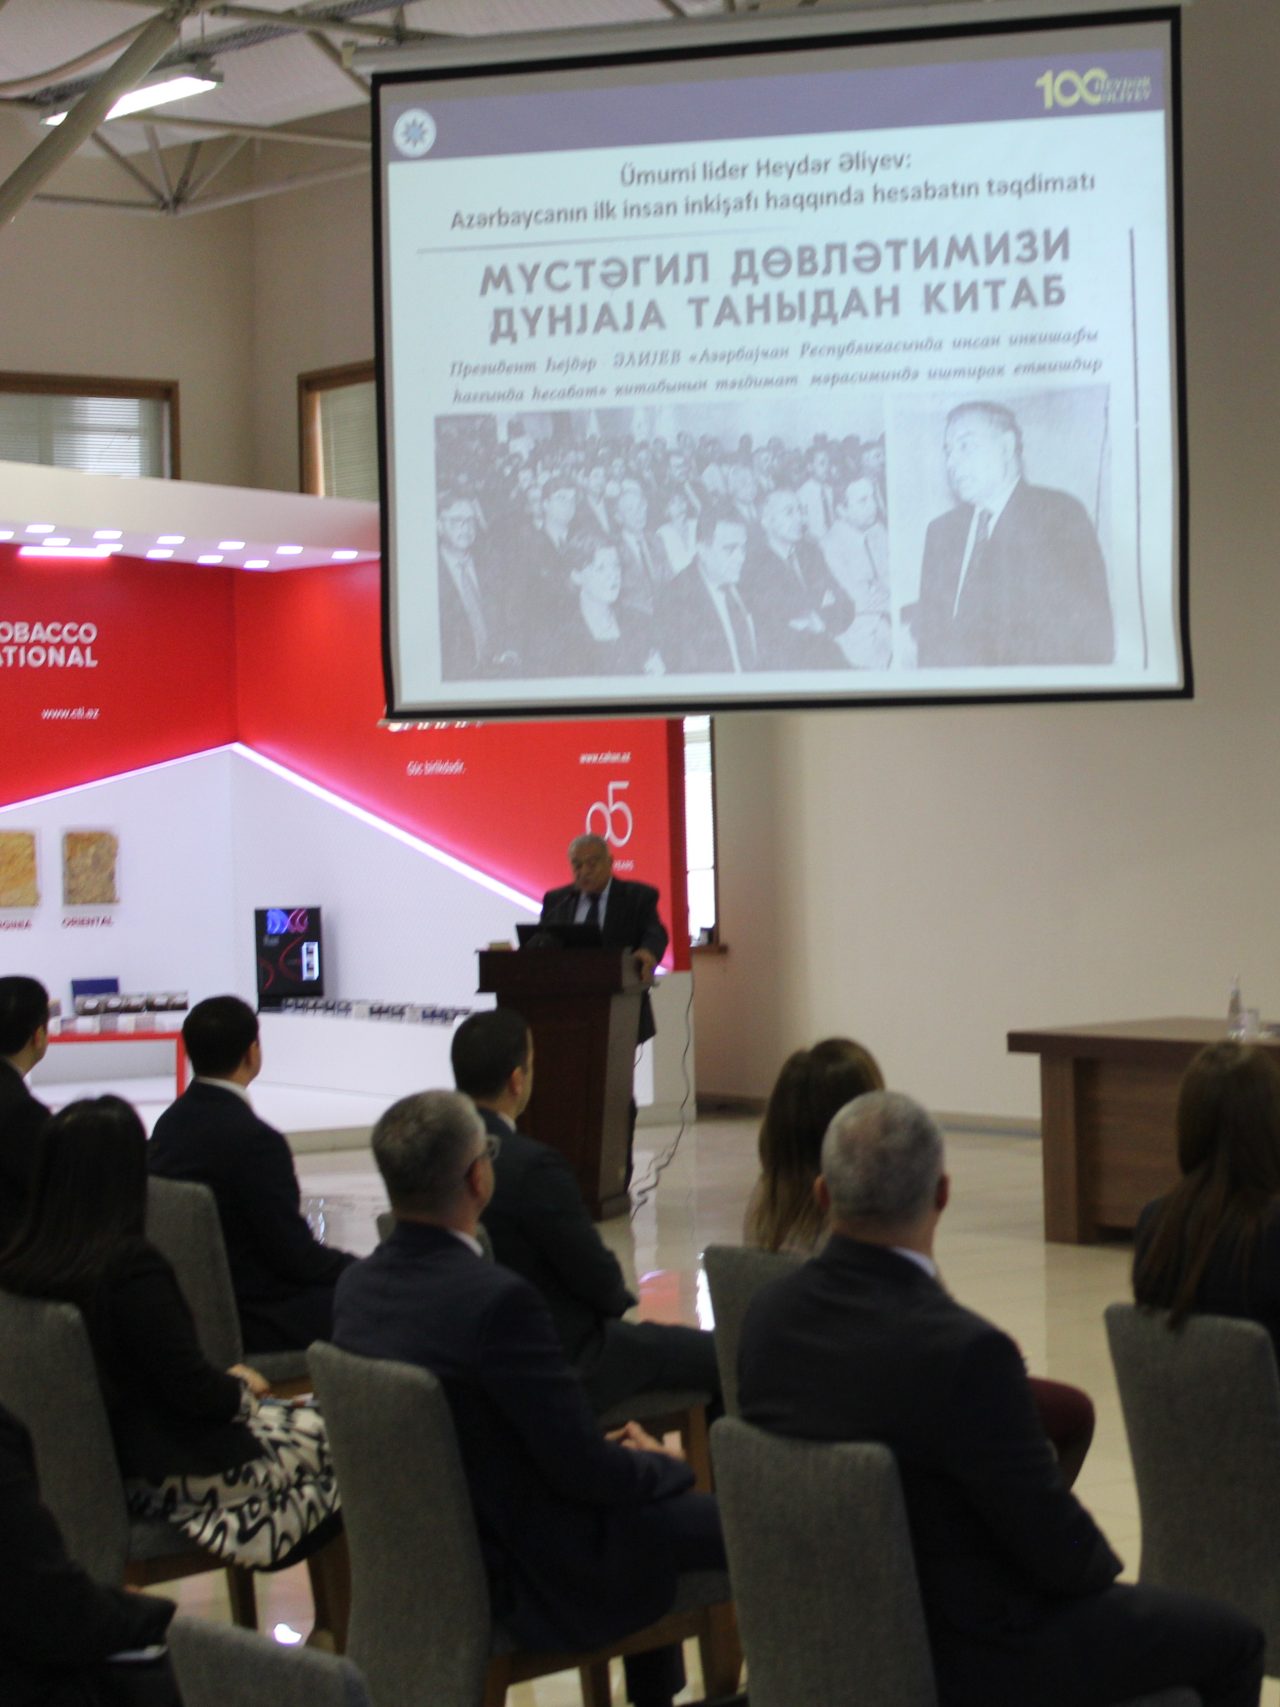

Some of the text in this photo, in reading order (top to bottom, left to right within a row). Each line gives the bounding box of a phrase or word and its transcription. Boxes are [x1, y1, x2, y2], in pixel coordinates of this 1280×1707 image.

[620, 150, 912, 187] Ümumi lider Heydər Əliyev:
[450, 172, 1095, 231] Azərbaycanın ilk insan inkişafı haqqında hesabatın təqdimatı
[688, 280, 900, 329] ТАНЫДАН
[923, 274, 1067, 316] КИТАБ
[0, 645, 98, 668] TIONAL
